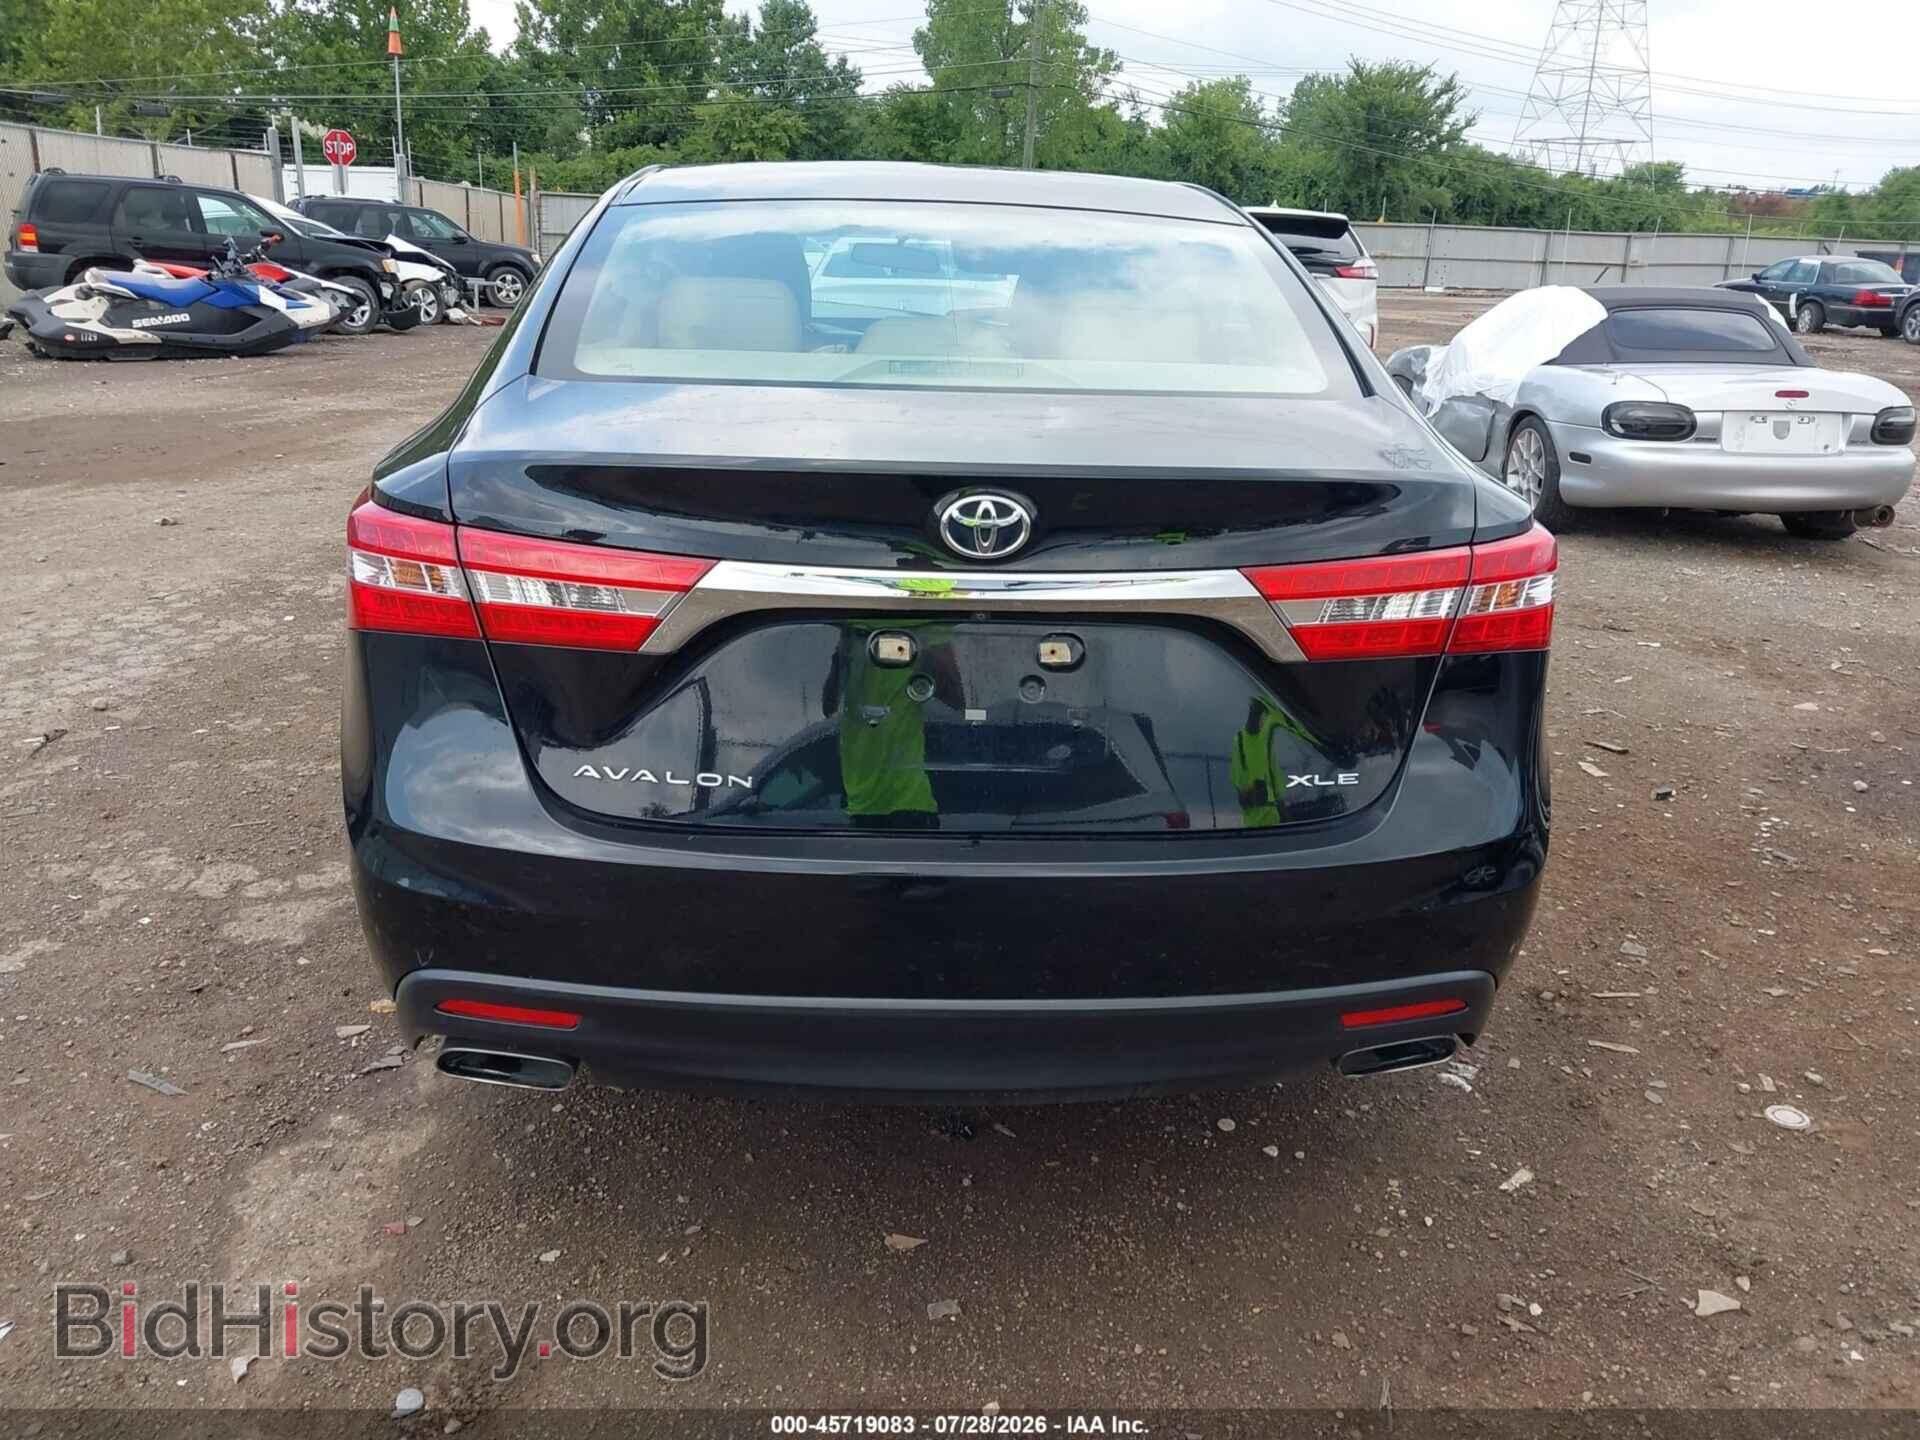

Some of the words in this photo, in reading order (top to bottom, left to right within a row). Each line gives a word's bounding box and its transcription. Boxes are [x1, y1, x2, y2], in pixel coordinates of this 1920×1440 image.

[325, 140, 354, 155] STOP
[573, 764, 753, 789] AVALON
[1286, 773, 1360, 789] XLE
